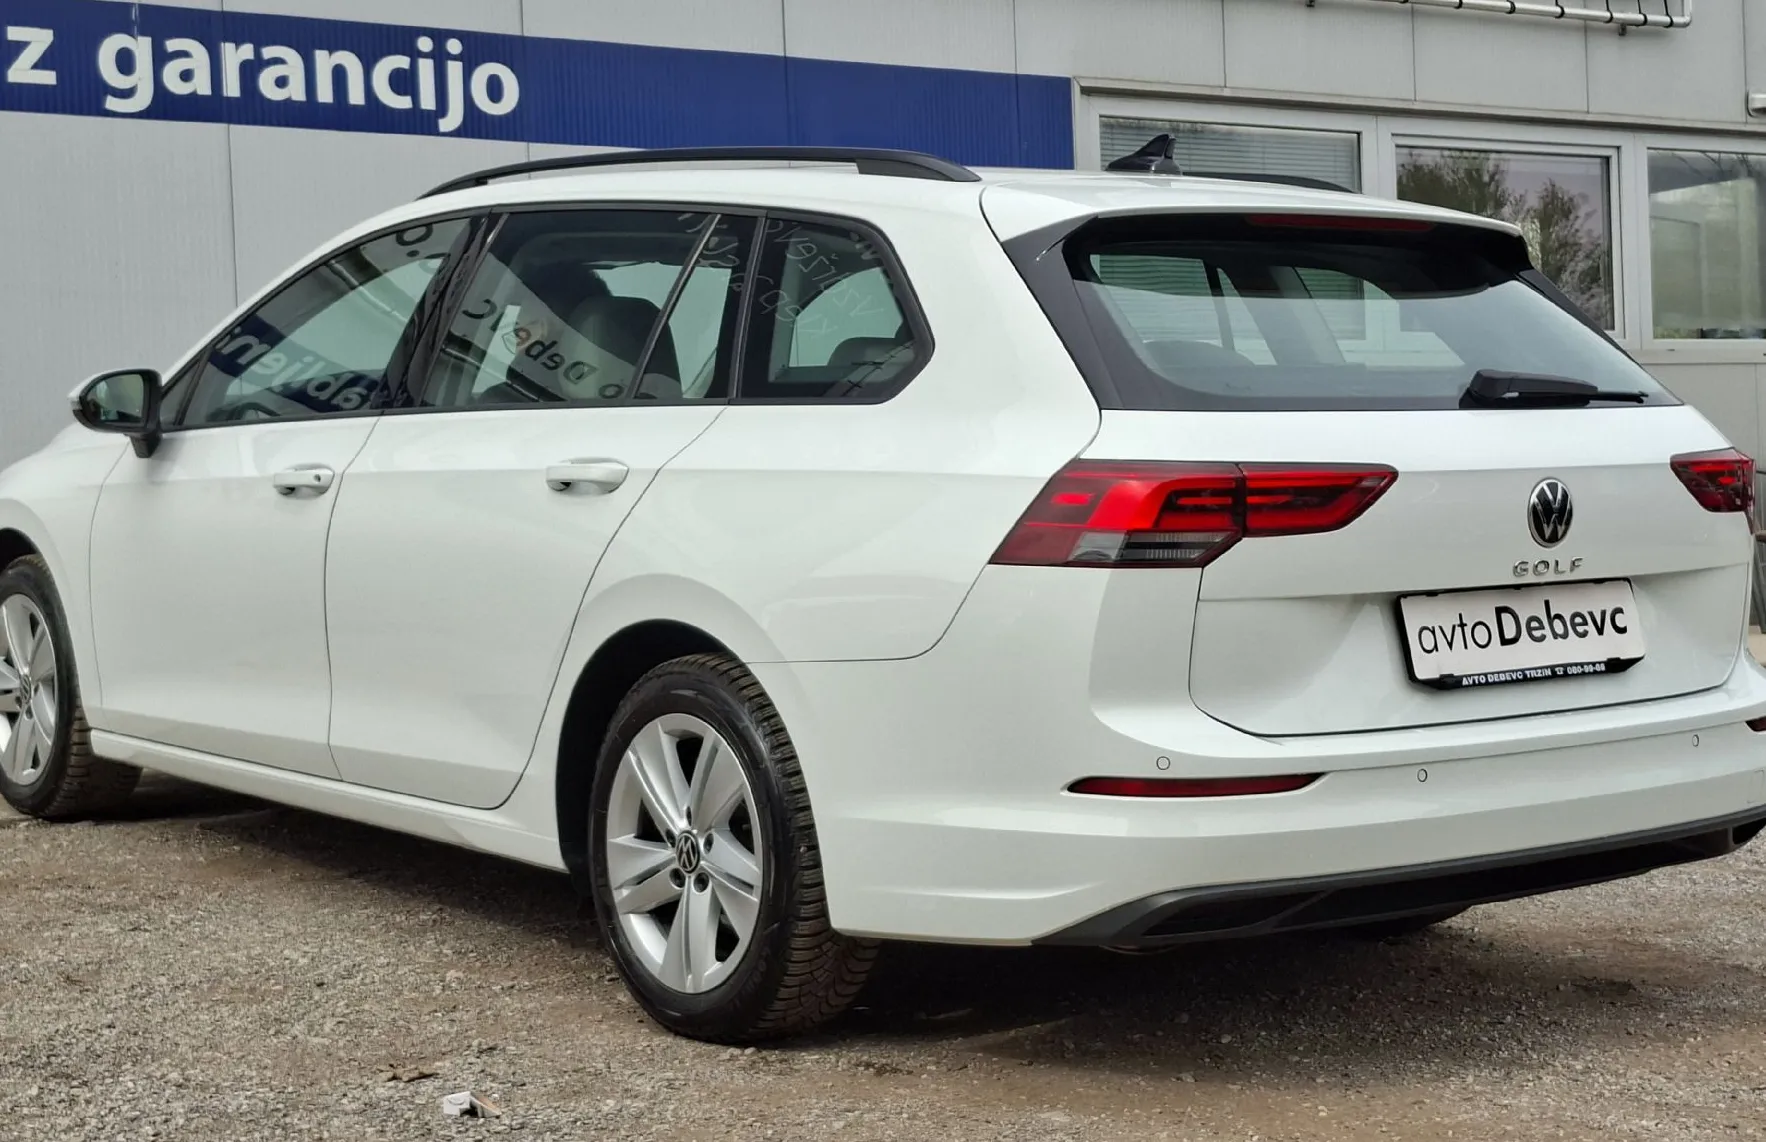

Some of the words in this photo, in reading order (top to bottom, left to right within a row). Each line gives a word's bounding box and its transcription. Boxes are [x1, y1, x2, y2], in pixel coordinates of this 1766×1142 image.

[6, 25, 58, 86] z
[98, 32, 521, 133] garancijo
[1512, 556, 1584, 578] GOLF
[1462, 675, 1487, 686] AVTO
[1487, 671, 1524, 683] DEBEVC
[1525, 669, 1552, 680] TRZIN
